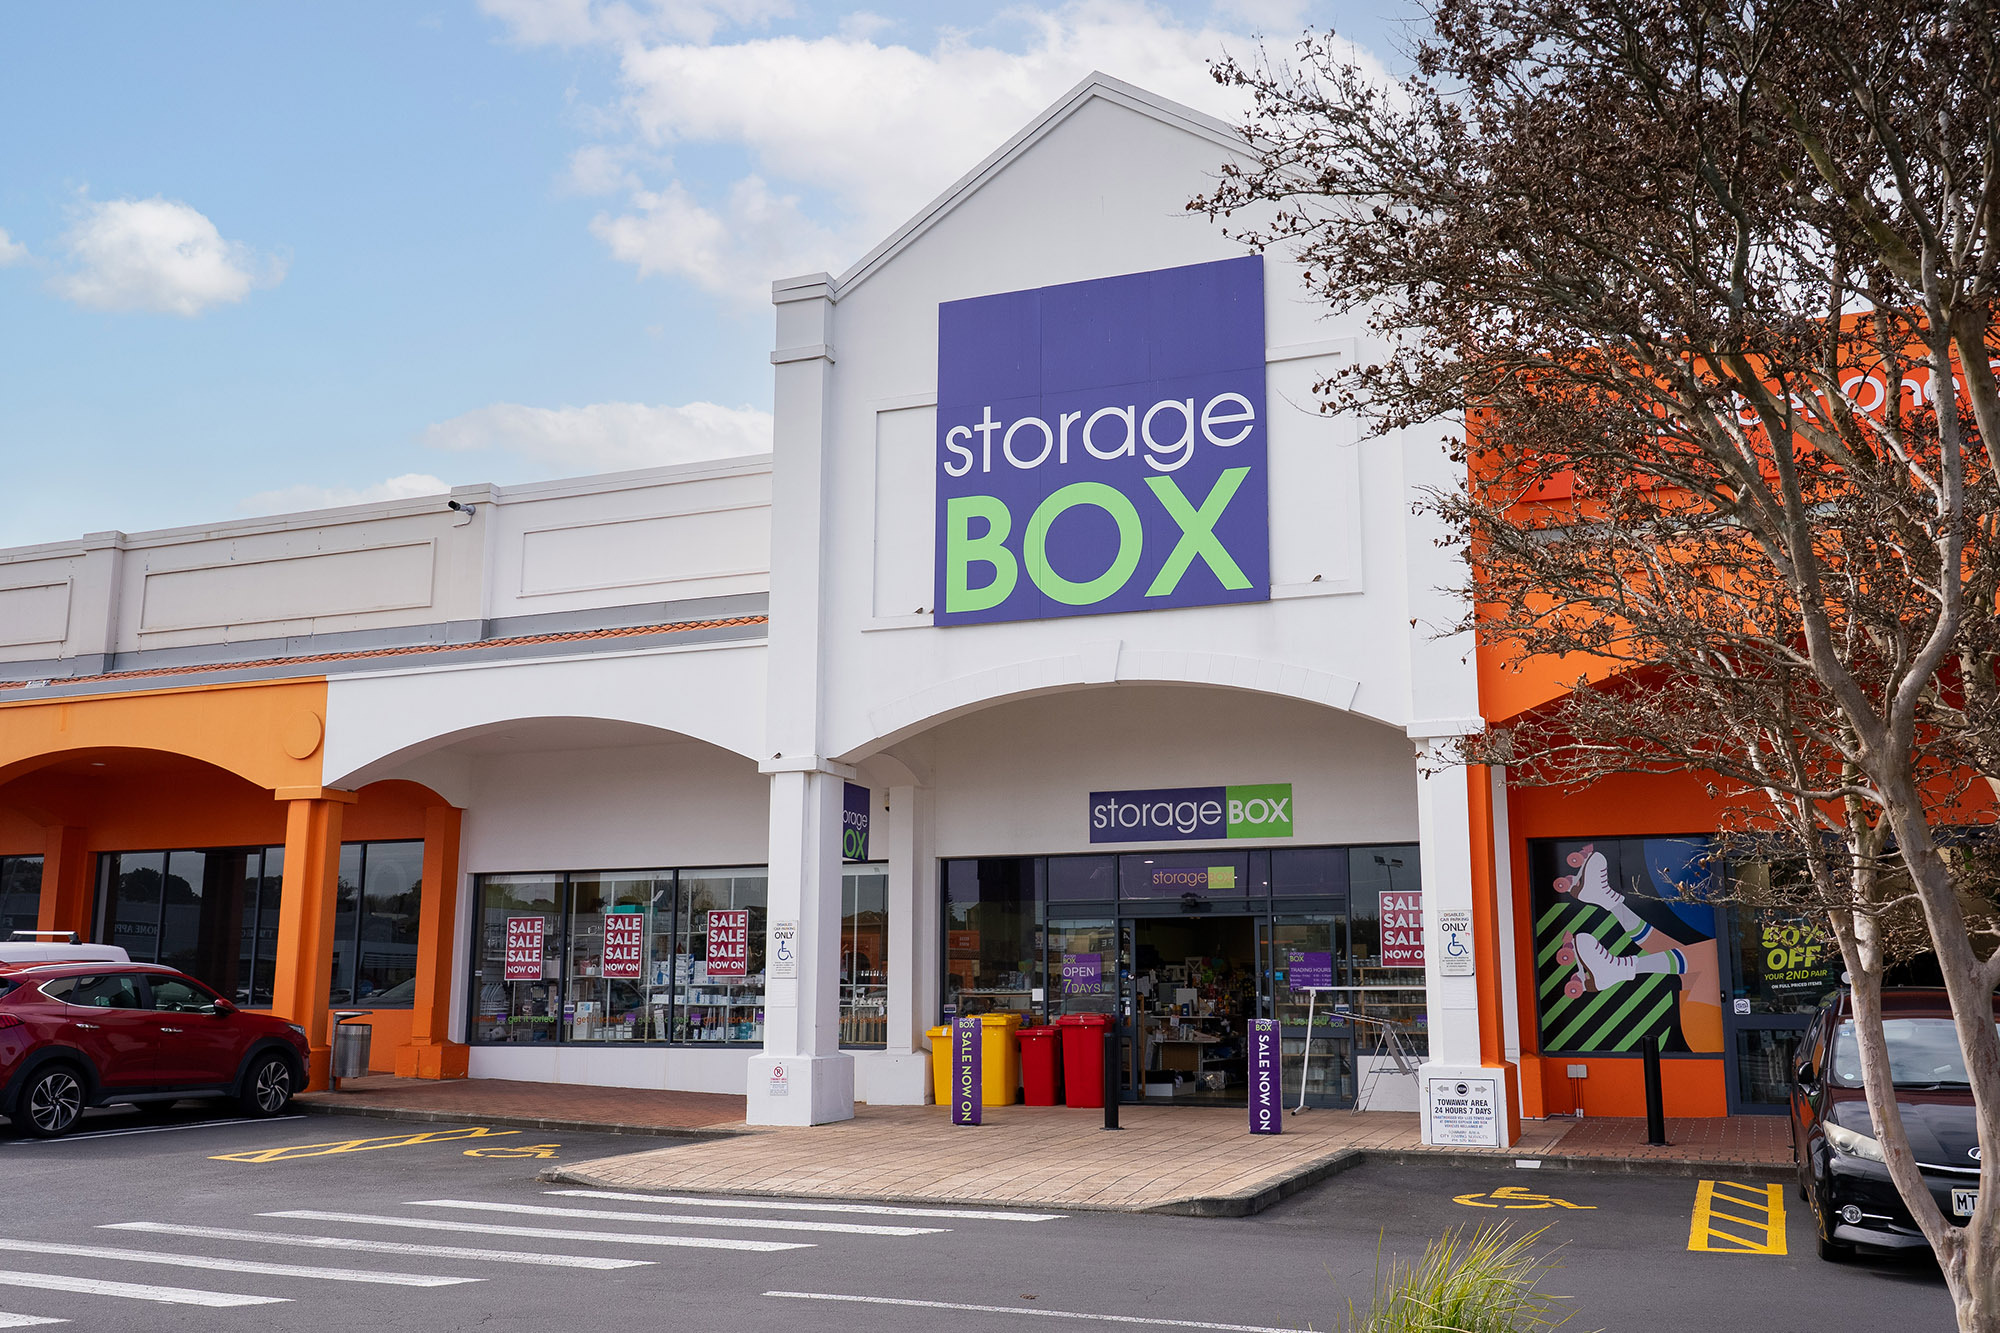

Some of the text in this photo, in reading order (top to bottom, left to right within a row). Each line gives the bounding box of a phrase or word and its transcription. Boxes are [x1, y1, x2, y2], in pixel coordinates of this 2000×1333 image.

[943, 392, 1255, 477] storage
[946, 466, 1254, 614] BOX
[843, 810, 868, 830] orage
[1093, 797, 1289, 834] storage BOX
[843, 829, 866, 860] OX
[1153, 871, 1233, 887] storage BOX
[509, 921, 542, 933] SALE
[607, 917, 640, 931] SALE
[710, 914, 745, 928] SALE
[1442, 923, 1467, 932] ONLY
[508, 935, 541, 948] SALE
[606, 932, 640, 945] SALE
[709, 929, 745, 942] SALE
[775, 931, 794, 939] ONLY
[1762, 924, 1825, 948] 50%
[508, 949, 540, 962] SALE
[605, 947, 639, 960] SALE
[709, 944, 744, 958] SALE
[1384, 949, 1424, 959] NOW O
[1767, 945, 1821, 970] OFF
[507, 965, 540, 974] NOW ON
[605, 963, 639, 971] NOW ON
[709, 961, 744, 969] NOW ON
[1063, 967, 1095, 977] OPEN
[1764, 969, 1828, 981] YOUR 2ND PAIR
[1063, 979, 1101, 993] 7 DAYS
[507, 1015, 521, 1024] get
[523, 1015, 529, 1023] it
[530, 1015, 555, 1023] sorted
[576, 1016, 589, 1025] get
[704, 1016, 717, 1025] get
[959, 1021, 975, 1029] BOX
[1255, 1024, 1272, 1032] BOX
[962, 1032, 972, 1062] SALE
[1259, 1035, 1270, 1068] SALE
[962, 1066, 972, 1098] NOW
[1259, 1072, 1271, 1106] NOW
[962, 1102, 972, 1121] ON
[1475, 1107, 1492, 1115] DAYS
[1259, 1109, 1271, 1130] ON
